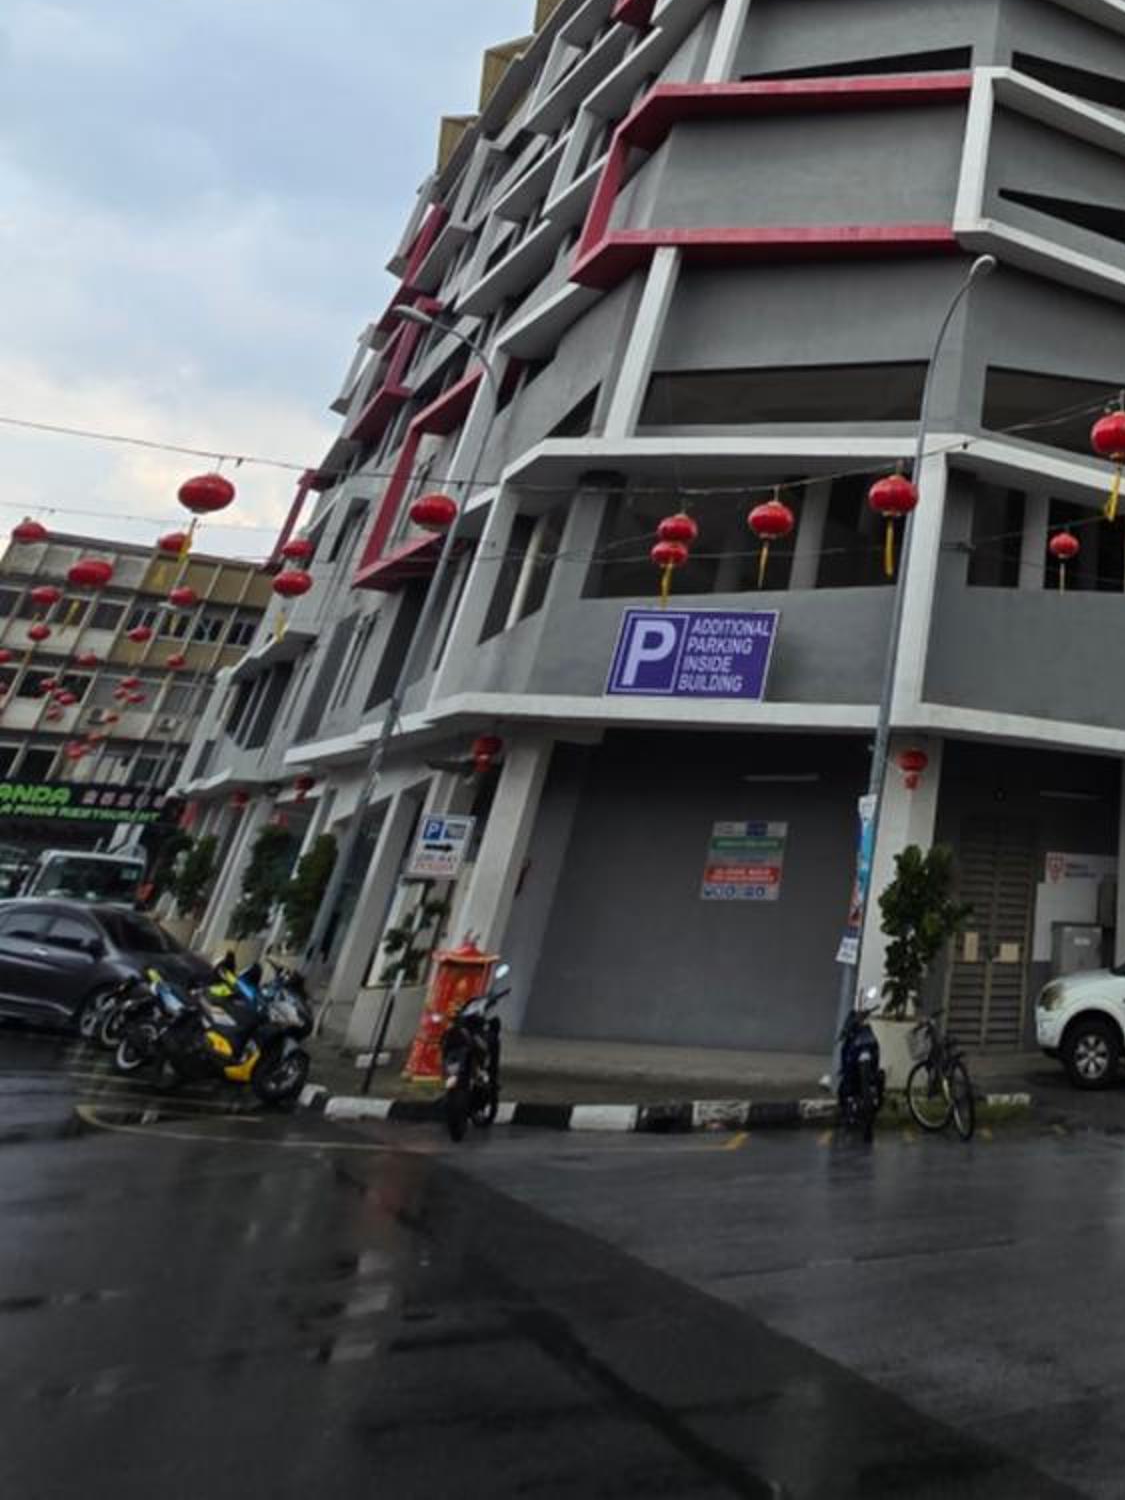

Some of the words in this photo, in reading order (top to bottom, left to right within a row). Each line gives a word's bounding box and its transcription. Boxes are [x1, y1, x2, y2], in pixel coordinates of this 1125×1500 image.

[690, 618, 770, 636] ADDITIONAL
[621, 620, 676, 686] P
[687, 637, 752, 654] PARKING
[682, 655, 734, 672] INSIDE
[677, 674, 743, 692] BUILDING
[426, 822, 440, 837] P
